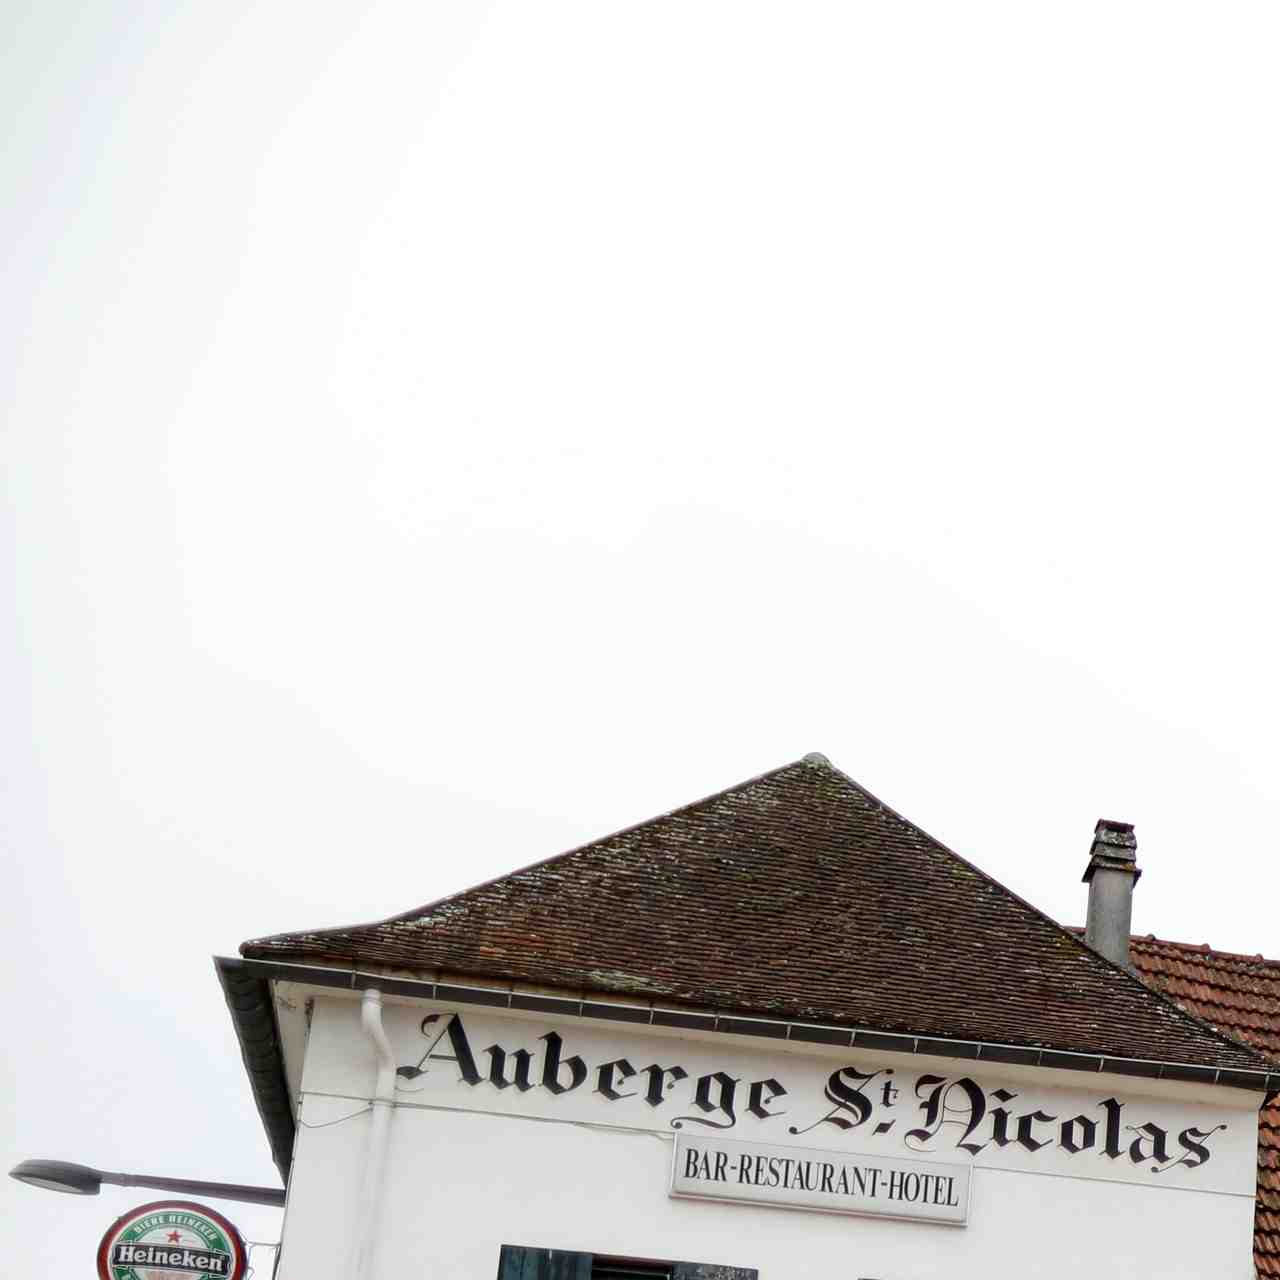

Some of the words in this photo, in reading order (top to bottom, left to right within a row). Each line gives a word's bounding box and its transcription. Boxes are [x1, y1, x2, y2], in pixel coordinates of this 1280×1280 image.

[396, 1012, 788, 1130] Auberge
[903, 1072, 1229, 1174] Nicolas
[683, 1147, 960, 1208] BAR-RESTAURANT-HOTEL
[118, 1245, 224, 1272] Heineken
